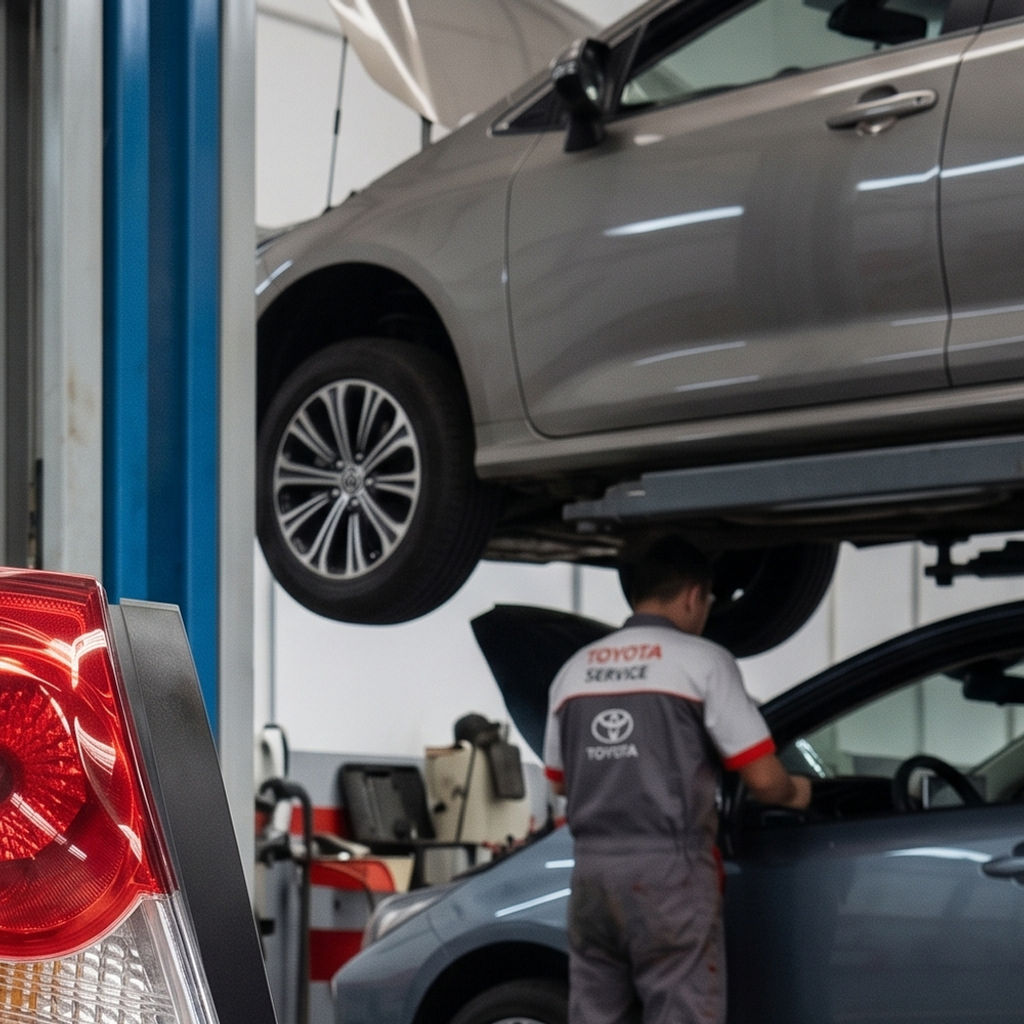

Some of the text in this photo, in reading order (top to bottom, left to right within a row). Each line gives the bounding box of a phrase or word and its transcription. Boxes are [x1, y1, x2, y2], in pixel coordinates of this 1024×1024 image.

[587, 643, 662, 664] TOYOTA
[585, 664, 647, 683] SERVICE
[586, 743, 638, 760] TOYOTA
